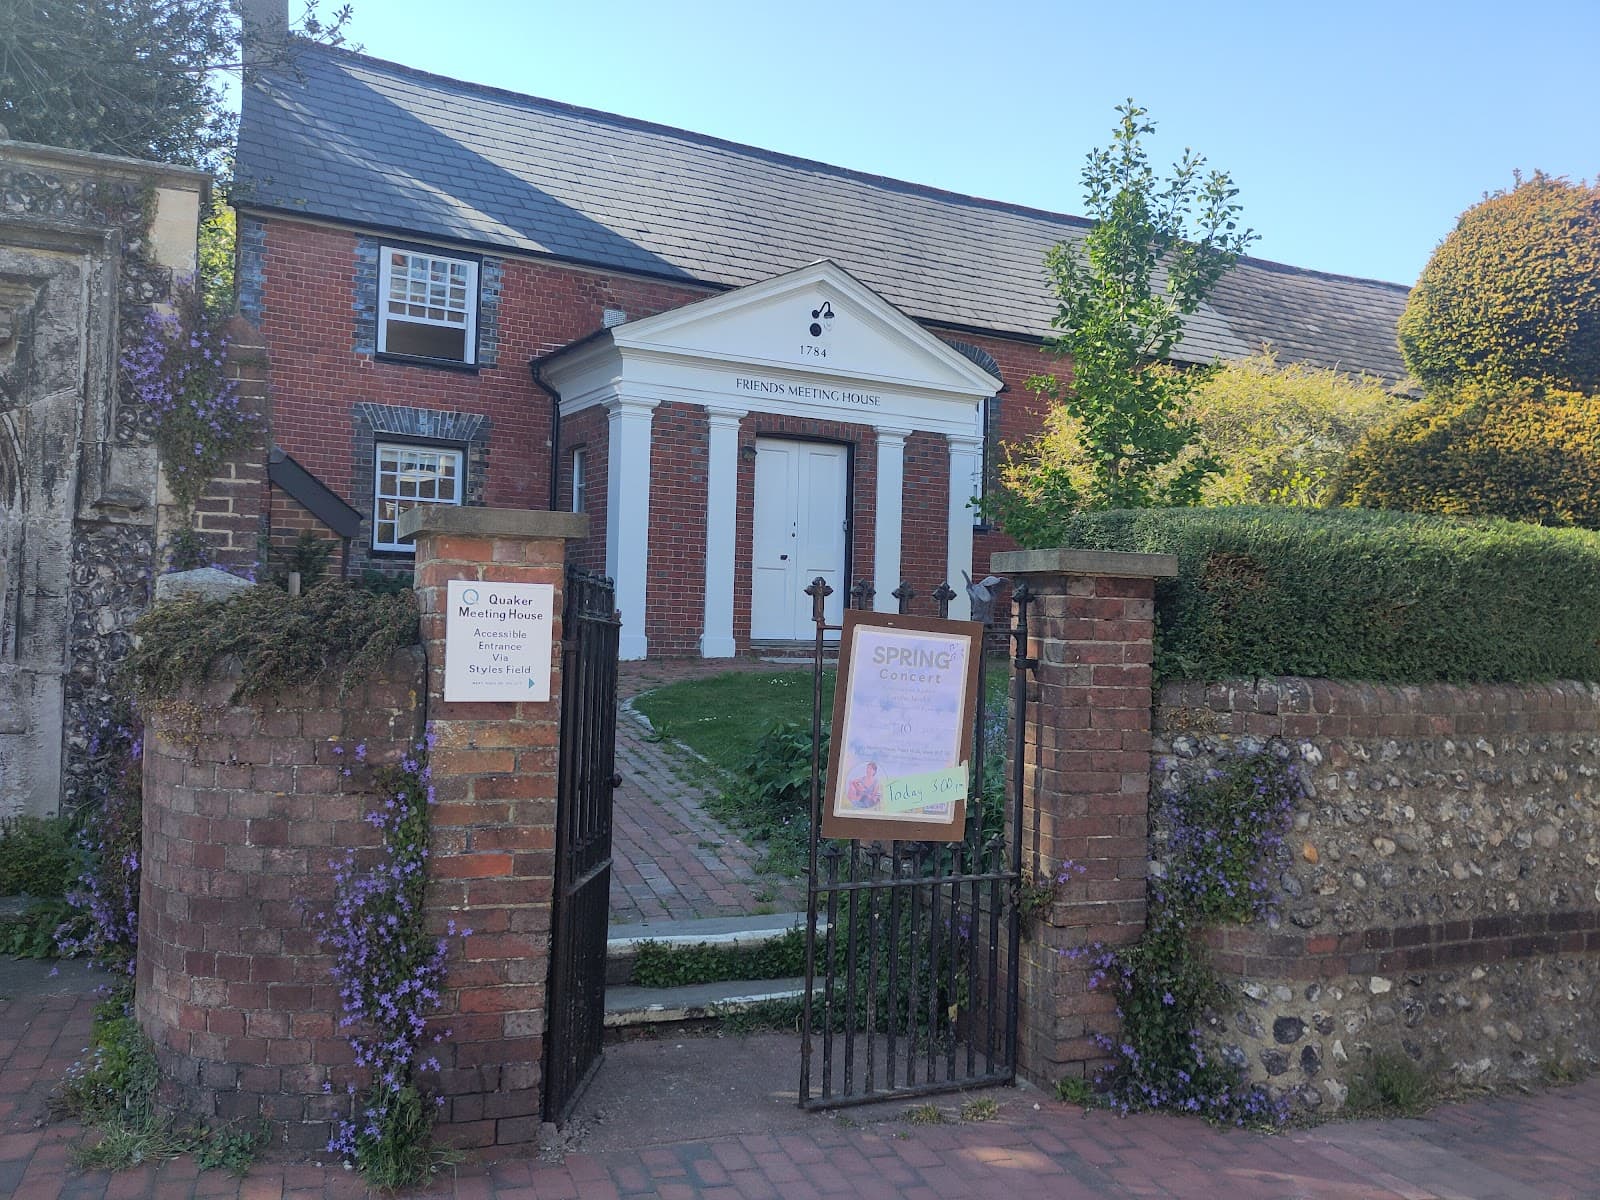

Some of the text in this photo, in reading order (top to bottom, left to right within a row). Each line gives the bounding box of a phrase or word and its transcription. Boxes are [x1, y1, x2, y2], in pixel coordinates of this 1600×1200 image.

[800, 345, 827, 357] 1784
[736, 378, 881, 407] FRIENDS MEETING HOUSE
[489, 594, 533, 606] Quaker
[459, 606, 543, 621] Meeting House
[473, 628, 527, 639] Accessible
[478, 641, 522, 651] Entrance
[492, 653, 509, 662] Via
[872, 646, 951, 670] SPRING
[469, 664, 531, 675] Styles Field
[879, 668, 942, 684] Concert
[886, 779, 924, 802] Today
